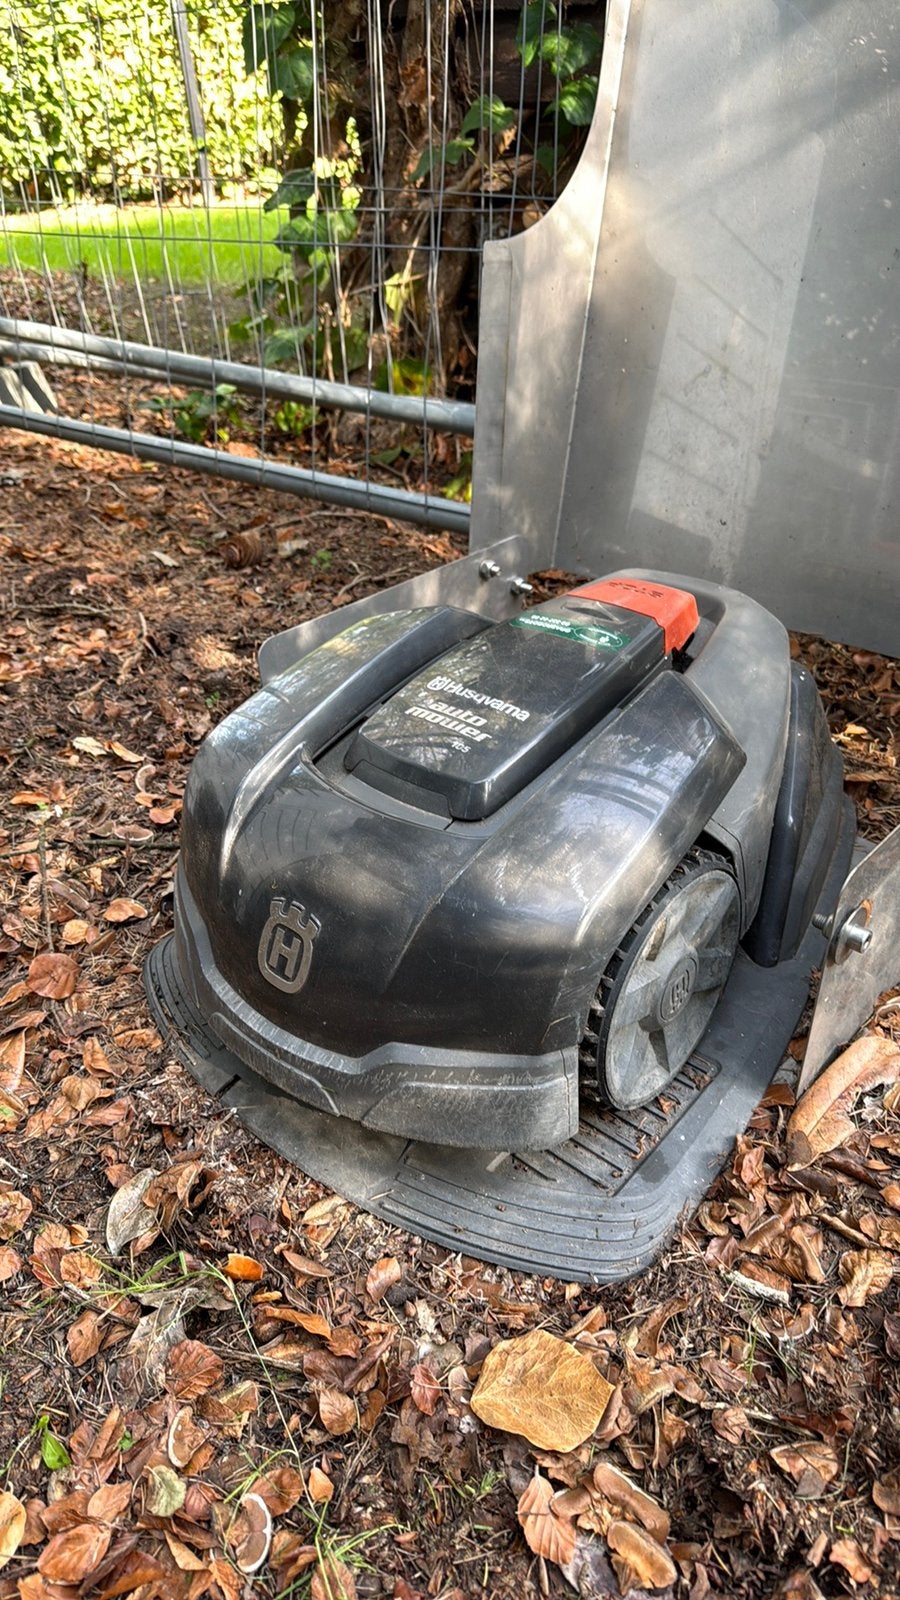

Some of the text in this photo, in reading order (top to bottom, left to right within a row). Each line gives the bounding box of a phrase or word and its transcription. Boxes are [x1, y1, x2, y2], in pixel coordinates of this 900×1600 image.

[429, 701, 488, 727] auto
[443, 678, 530, 722] Husqvarna
[404, 706, 492, 742] mower
[451, 741, 472, 753] 105
